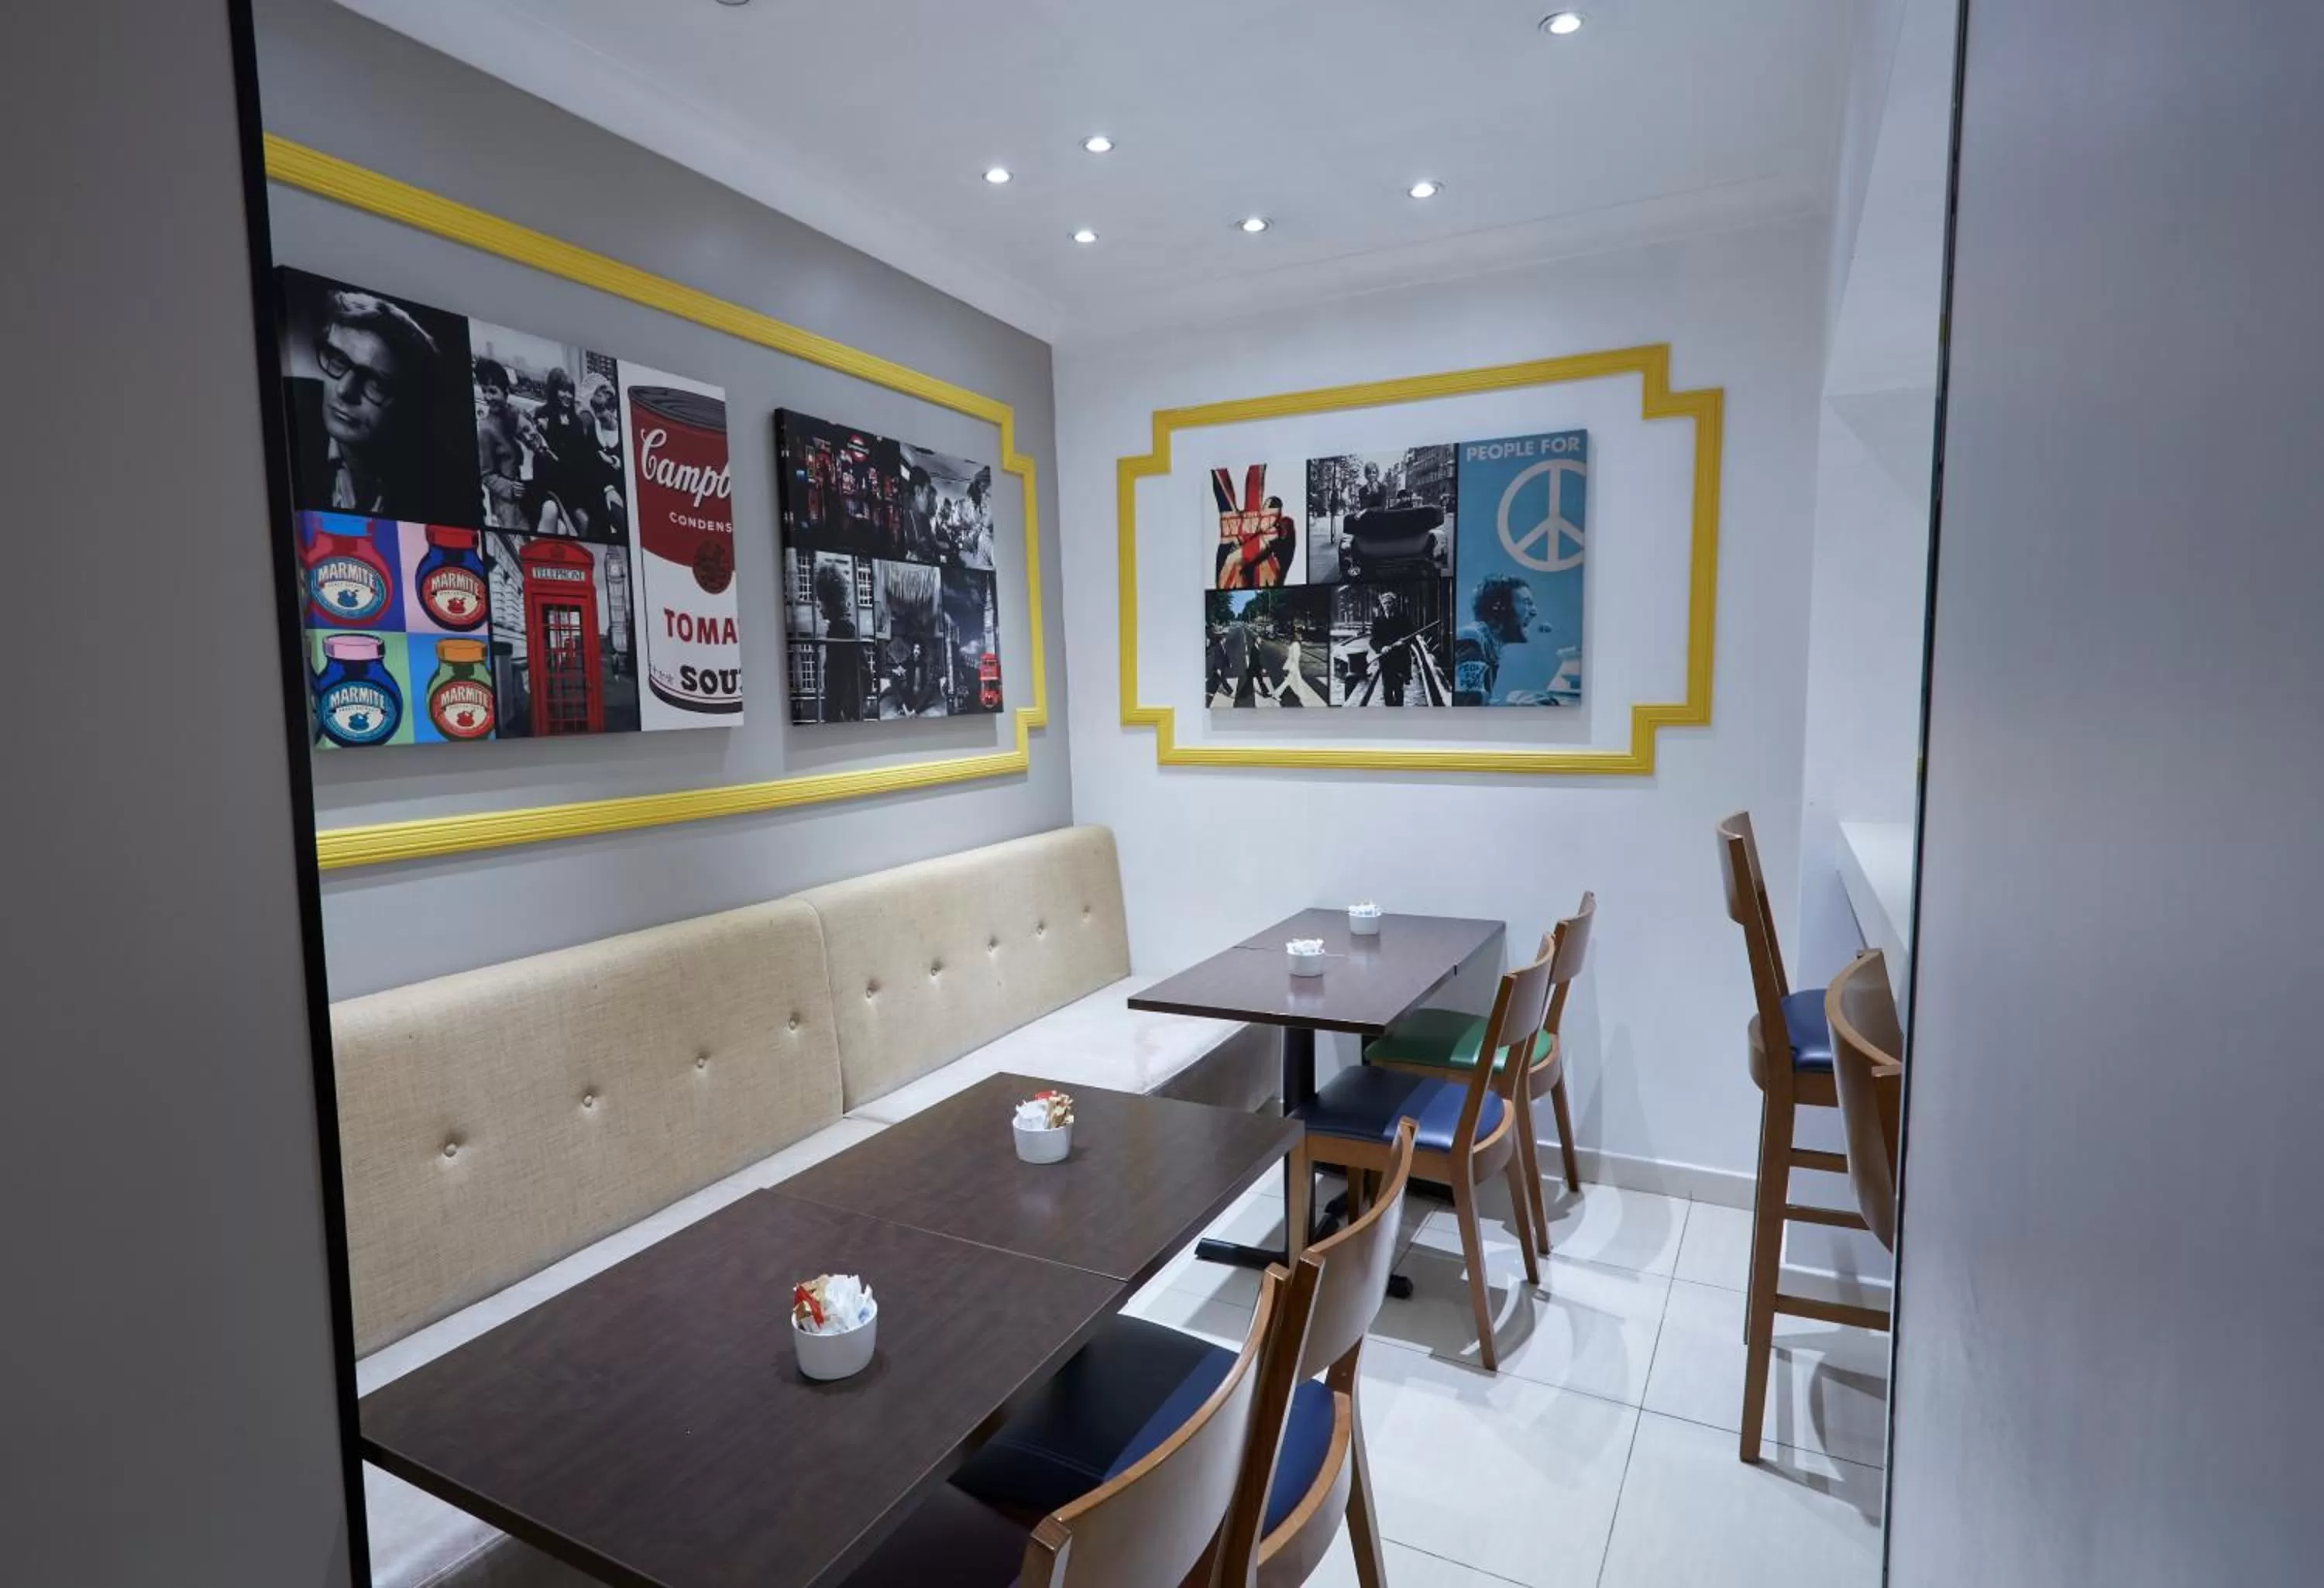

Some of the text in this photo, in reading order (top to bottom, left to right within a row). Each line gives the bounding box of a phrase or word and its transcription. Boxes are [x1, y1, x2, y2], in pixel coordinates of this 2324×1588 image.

[1466, 436, 1580, 462] PEOPLE FOR
[669, 511, 733, 533] CONDENS
[318, 562, 376, 591] MARMITE
[431, 572, 480, 596] MARMITE
[664, 607, 738, 645] TOMA
[329, 687, 385, 710] MARMITE
[441, 686, 489, 708] MARMITE
